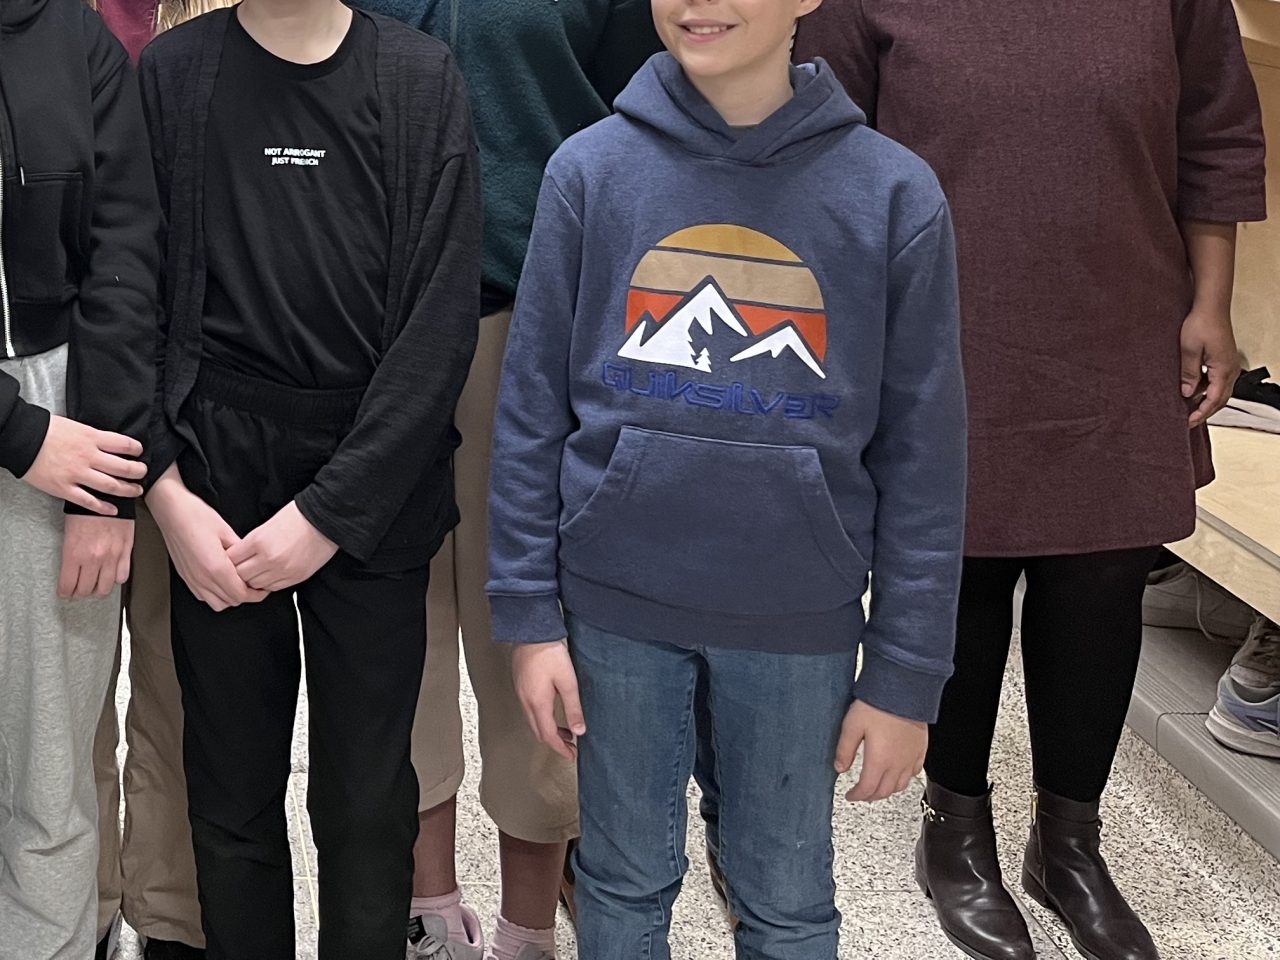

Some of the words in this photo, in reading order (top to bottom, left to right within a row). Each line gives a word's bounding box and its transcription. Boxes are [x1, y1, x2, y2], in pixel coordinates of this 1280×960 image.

[264, 148, 282, 156] NOT
[283, 148, 326, 158] ARROGANT
[271, 157, 290, 166] JUST
